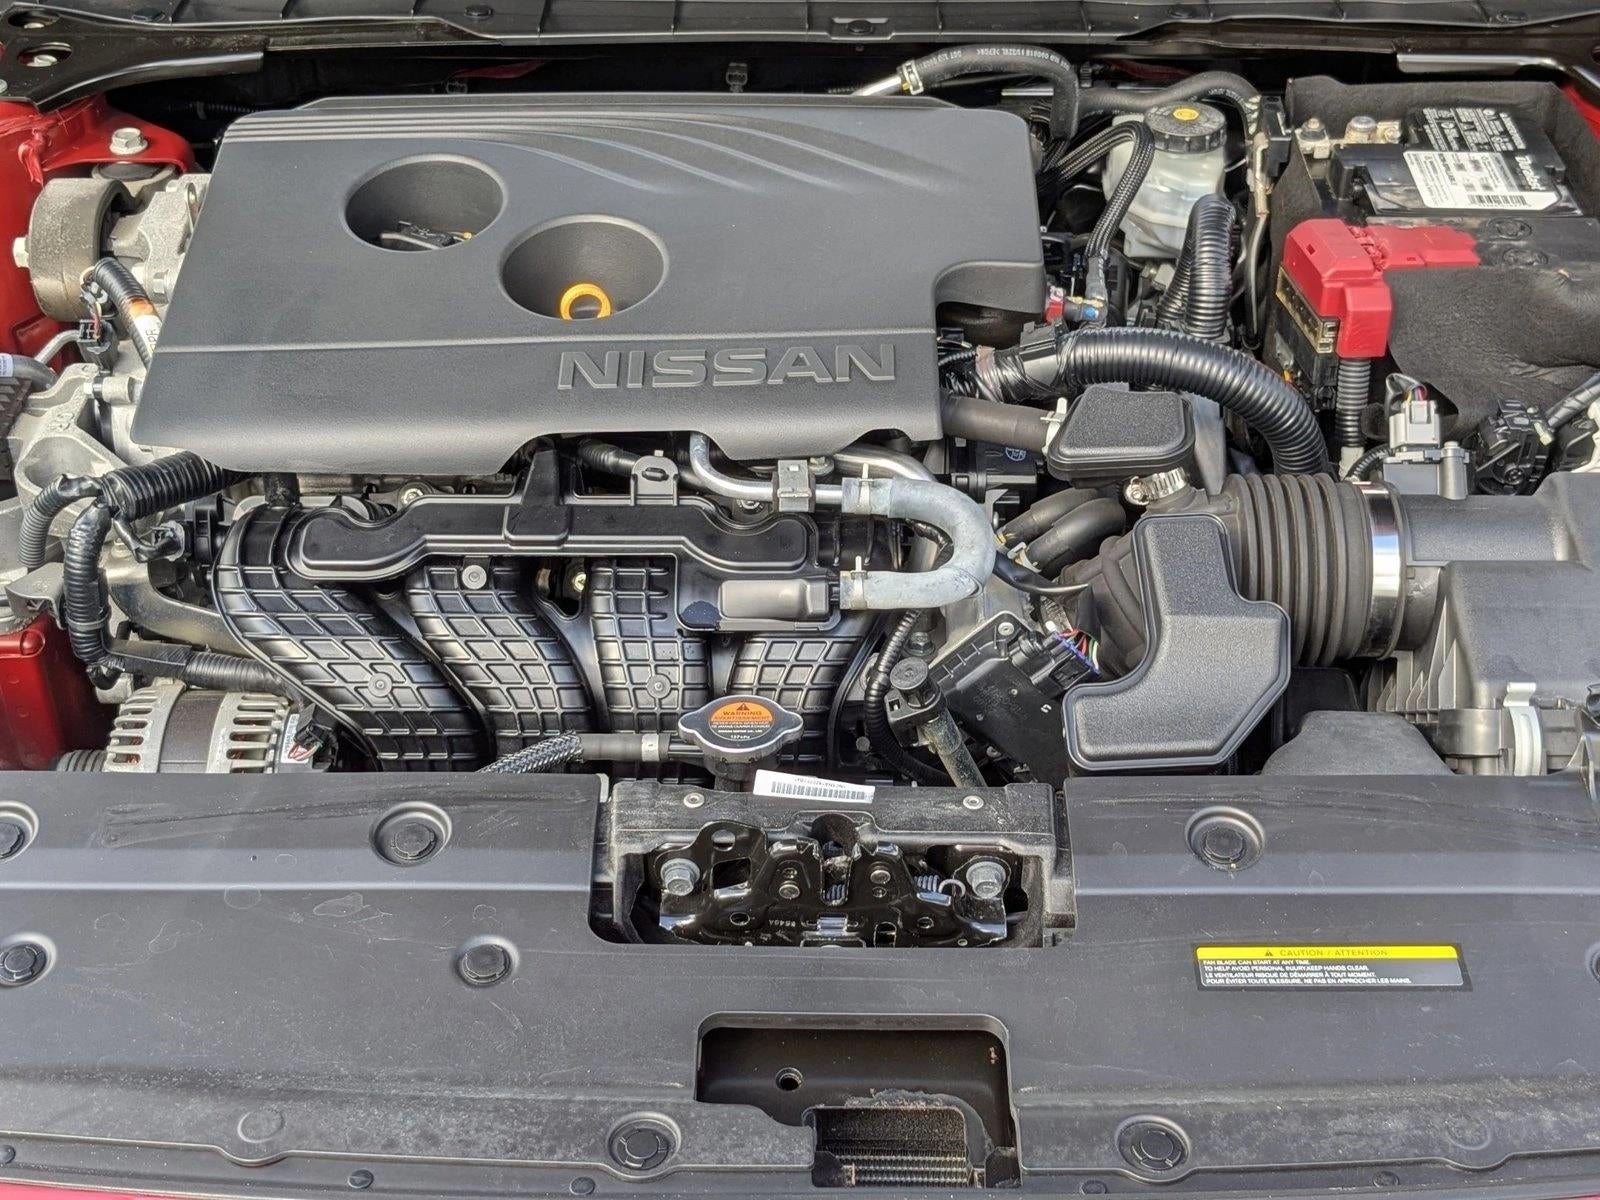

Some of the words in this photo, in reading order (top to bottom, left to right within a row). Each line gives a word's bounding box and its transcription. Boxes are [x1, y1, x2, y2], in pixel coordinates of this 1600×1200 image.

[557, 343, 896, 390] NISSAN
[1289, 970, 1324, 978] DÉMARRER
[1225, 977, 1247, 985] ÉVITER
